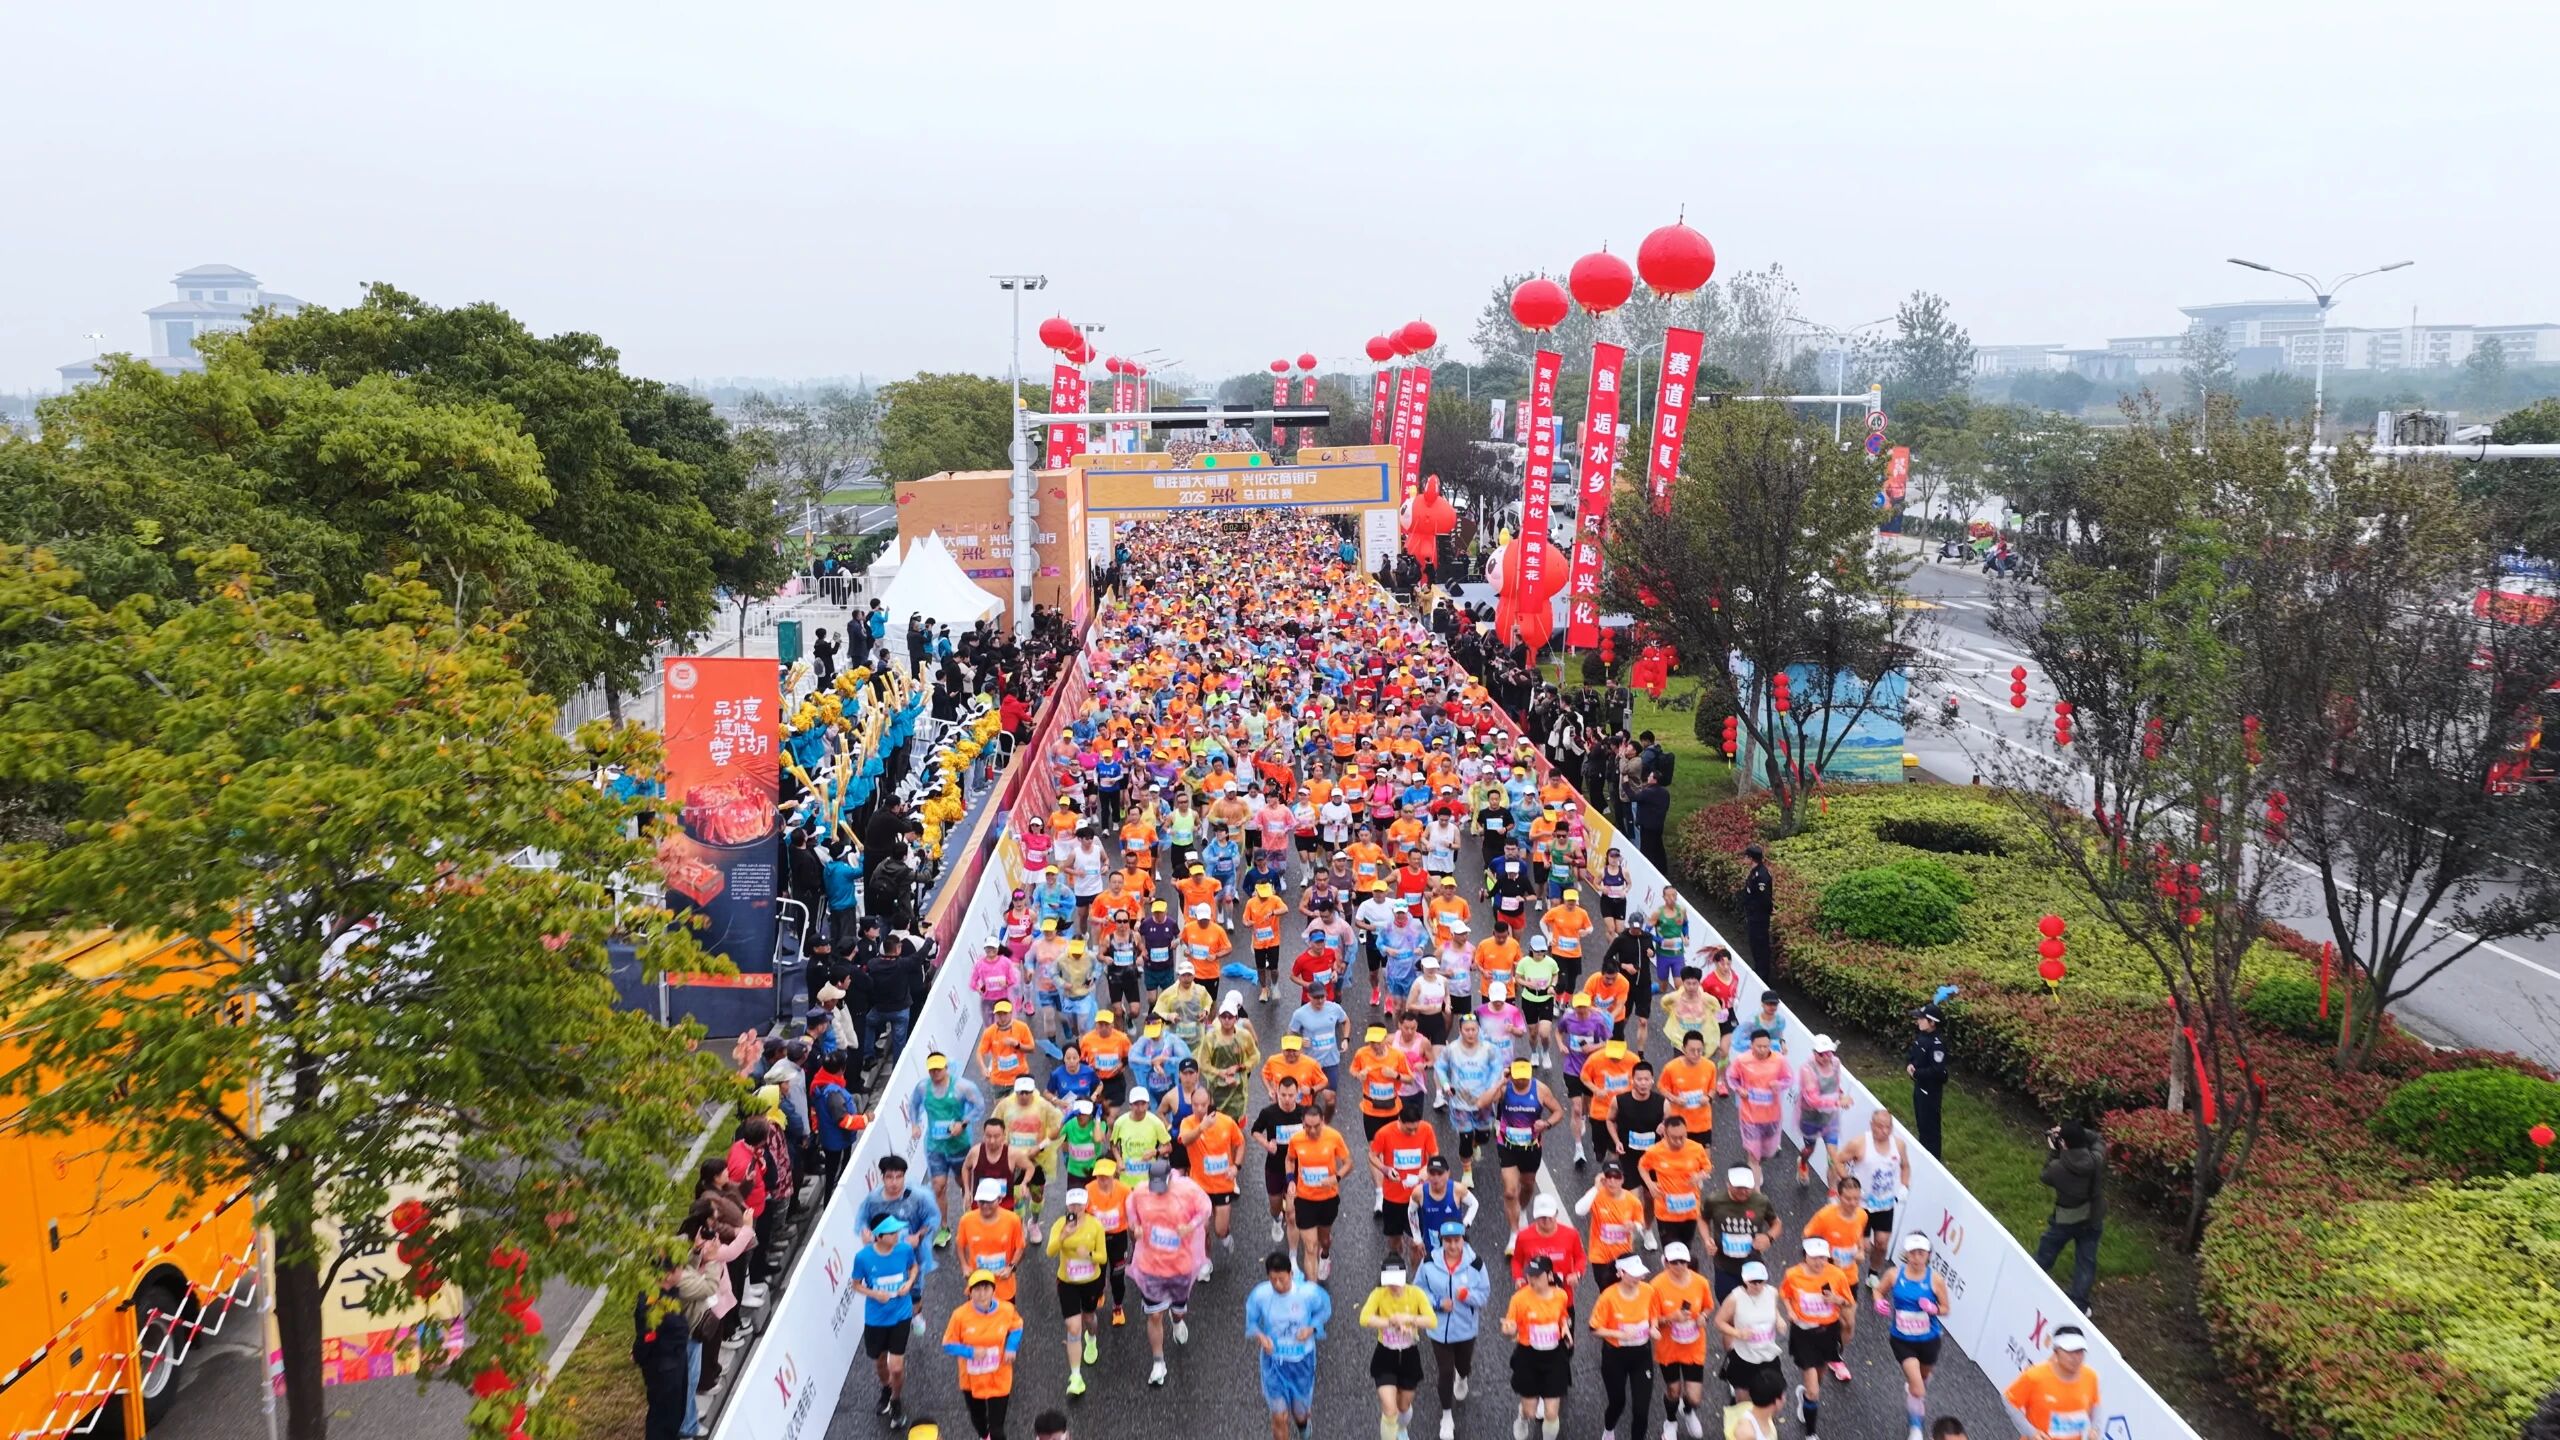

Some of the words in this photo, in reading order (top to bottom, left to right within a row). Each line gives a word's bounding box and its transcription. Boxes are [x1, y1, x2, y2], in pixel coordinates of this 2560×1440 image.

[1053, 377, 1068, 443] 千垛画
[1871, 417, 1883, 427] 40
[1534, 416, 1552, 457] 更青春
[1211, 488, 1238, 503] 兴化
[1242, 489, 1293, 501] 马拉松赛
[1529, 466, 1548, 519] 跑马兴化
